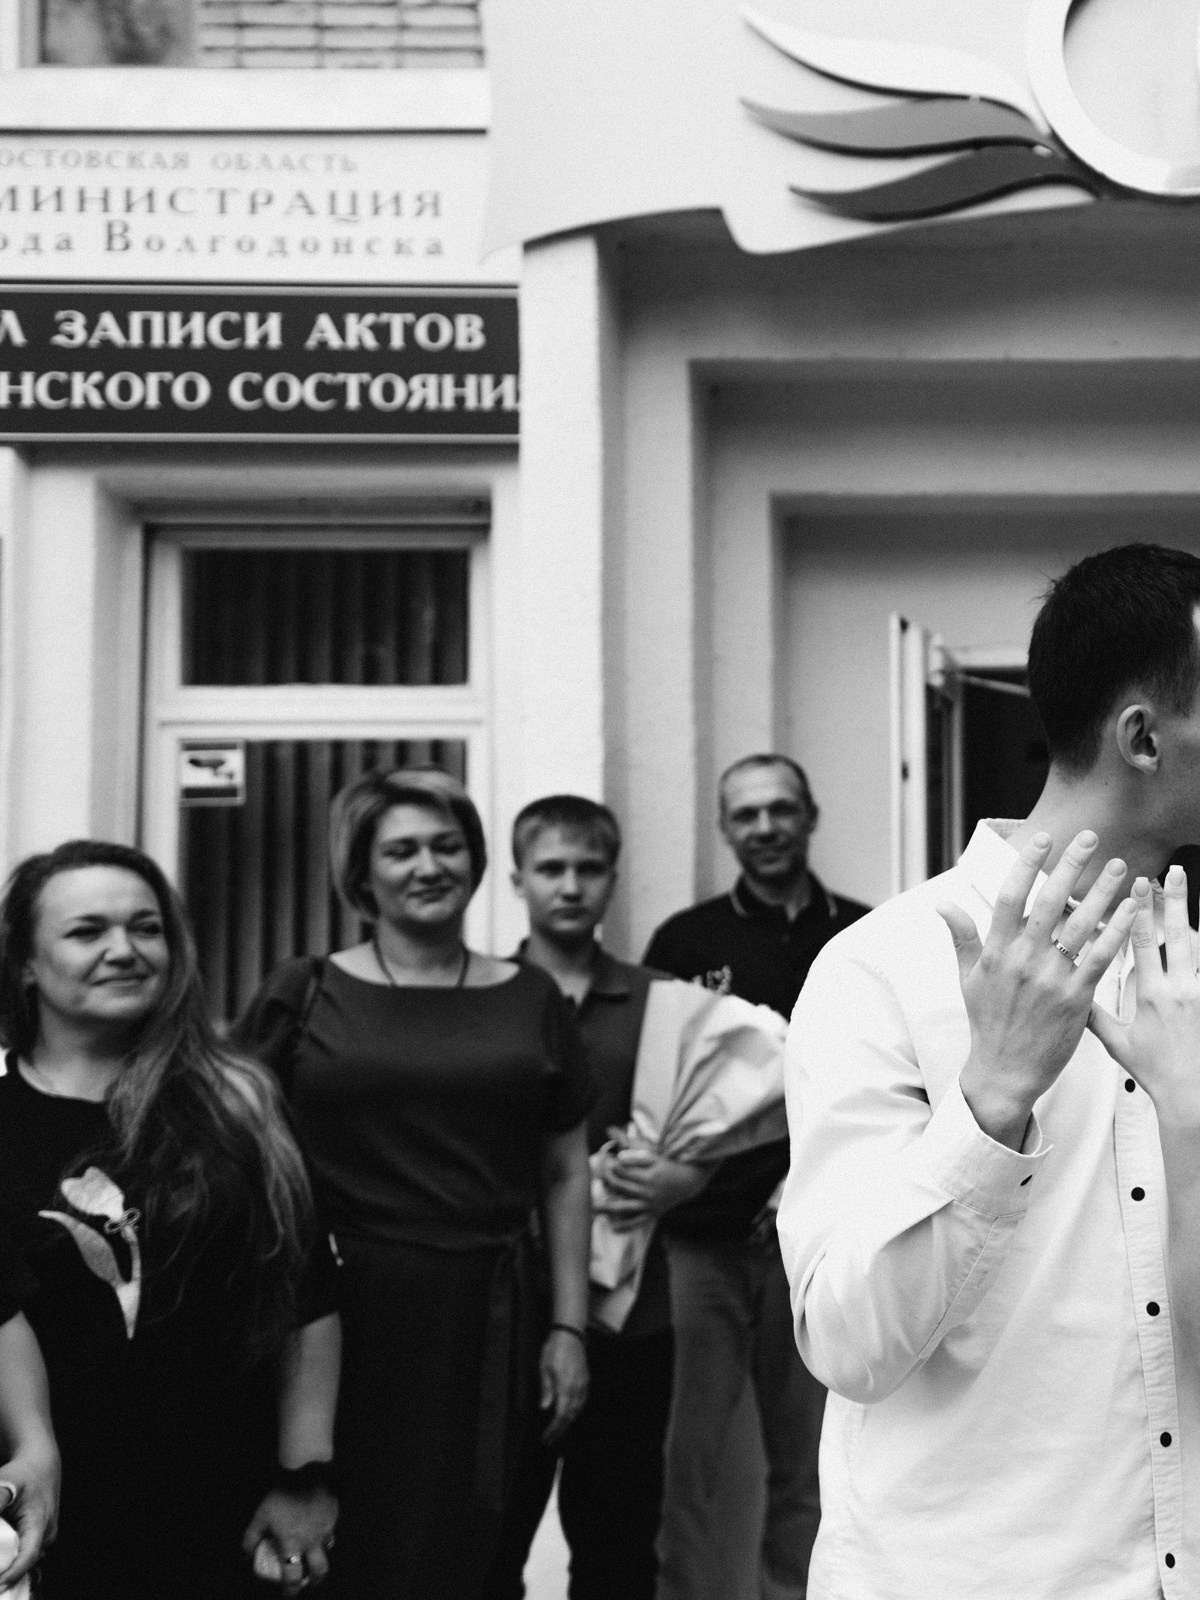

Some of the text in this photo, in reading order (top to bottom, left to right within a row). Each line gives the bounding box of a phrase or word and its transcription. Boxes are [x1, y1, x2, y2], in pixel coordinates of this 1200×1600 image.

[210, 151, 358, 173] ОБЛАСТЬ
[104, 219, 445, 257] Волгодонска
[51, 310, 283, 350] ЗАПИСИ
[305, 312, 487, 351] АКТОВ
[0, 371, 519, 412] НСКОГО СОСТОЯНИ
